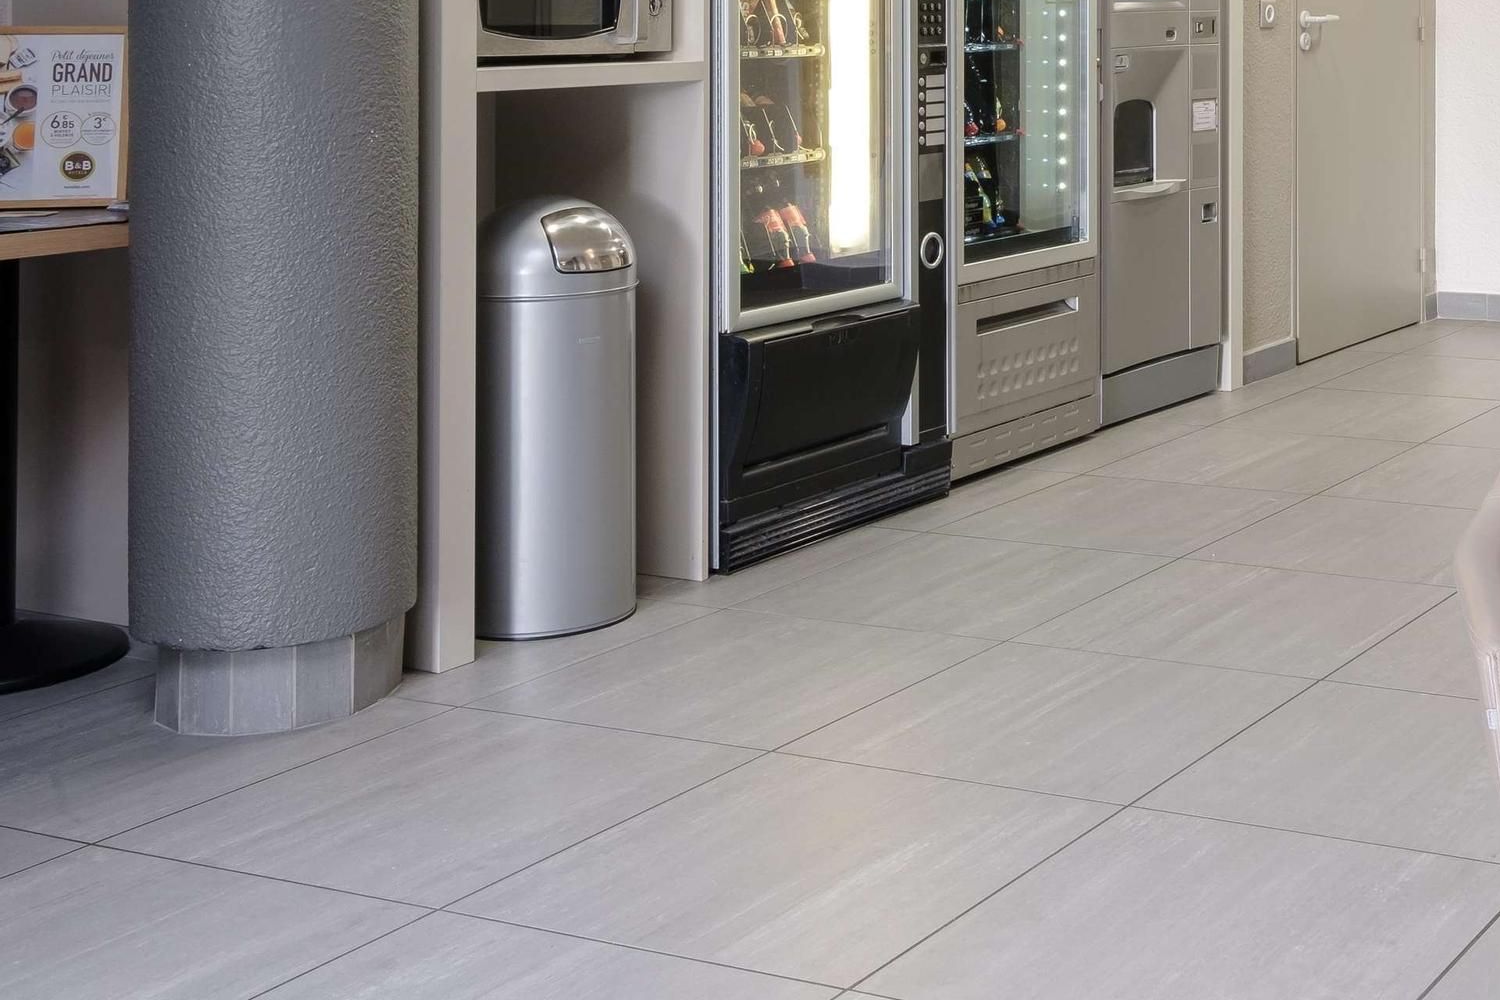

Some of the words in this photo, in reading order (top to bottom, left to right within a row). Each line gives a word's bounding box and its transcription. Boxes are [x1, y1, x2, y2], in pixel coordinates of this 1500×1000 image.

[51, 49, 74, 62] Petit
[52, 62, 113, 83] GRAND
[65, 160, 92, 171] B&B
